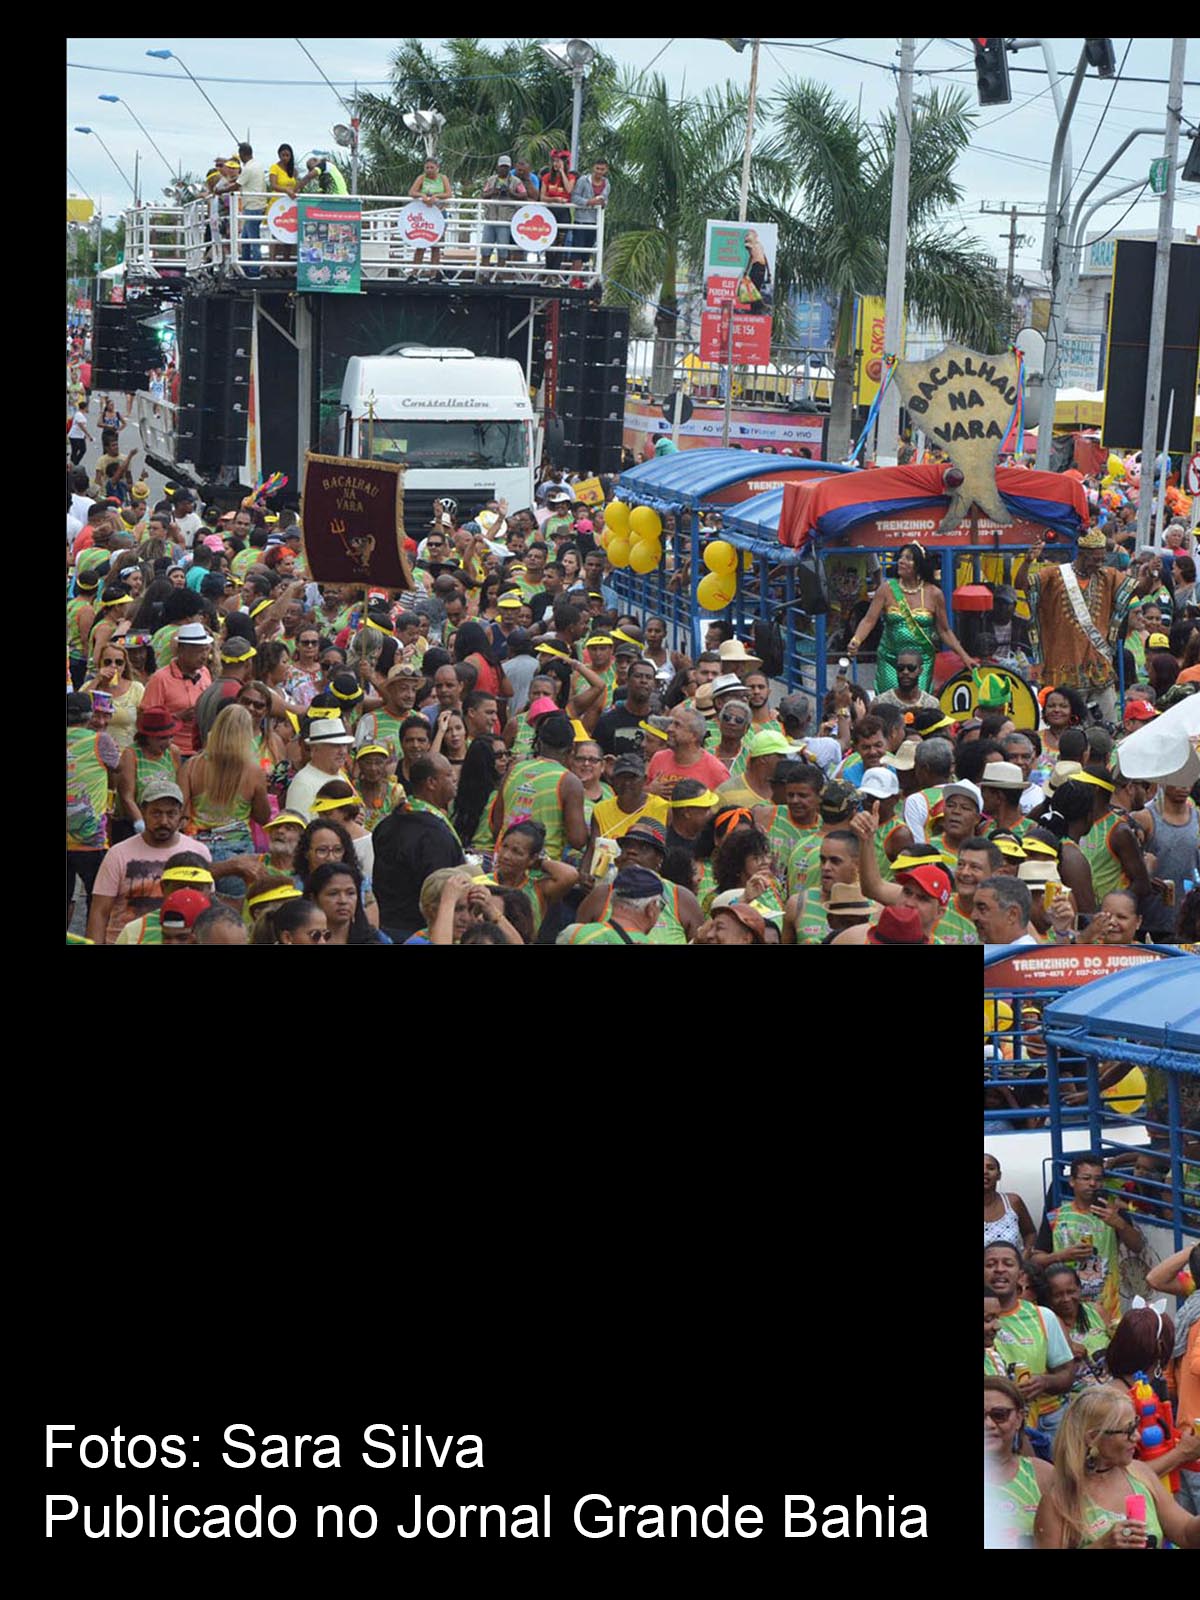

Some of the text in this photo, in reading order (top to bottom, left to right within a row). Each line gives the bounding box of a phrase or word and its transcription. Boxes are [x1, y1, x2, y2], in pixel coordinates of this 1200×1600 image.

[871, 316, 886, 355] SKOL
[908, 357, 1019, 414] BACALHAU
[401, 398, 490, 409] Constellation
[948, 389, 985, 411] NA
[934, 420, 1003, 443] VARA
[322, 475, 380, 497] BACALHAU
[343, 489, 356, 500] NA
[336, 498, 364, 512] VARA
[876, 519, 936, 532] TRENZINHO
[1012, 957, 1079, 971] TRENZINHO
[1083, 957, 1102, 968] DO
